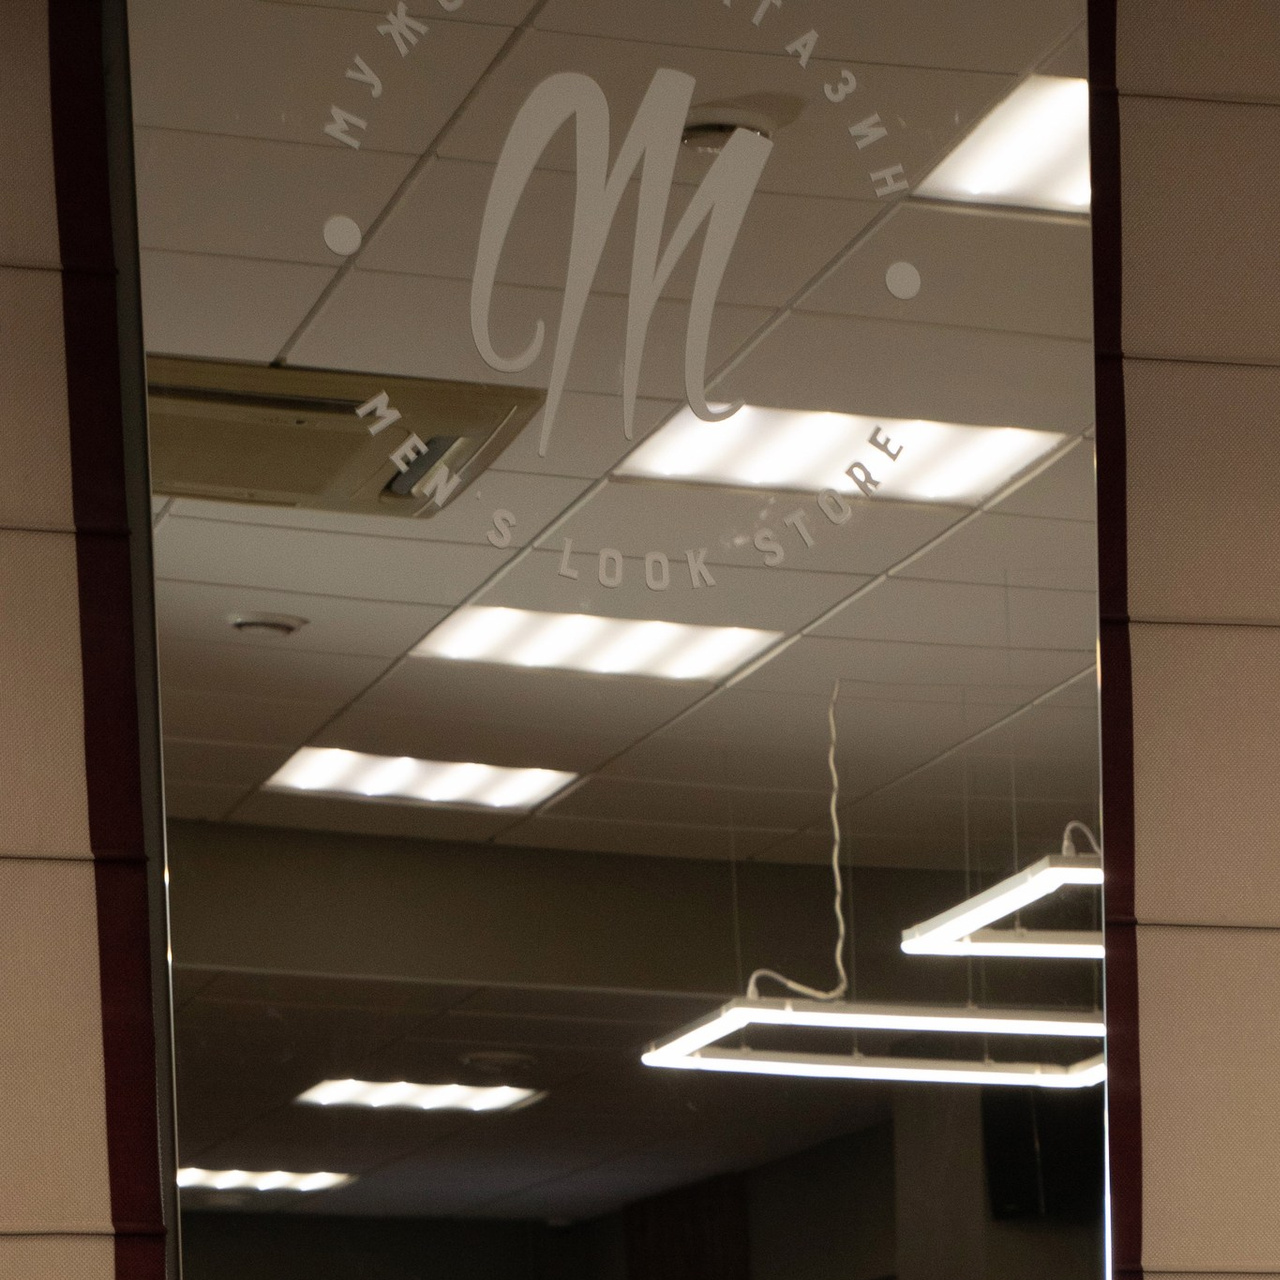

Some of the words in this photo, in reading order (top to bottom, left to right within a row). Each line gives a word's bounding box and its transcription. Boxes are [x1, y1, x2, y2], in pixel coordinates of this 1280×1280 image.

[323, 0, 463, 150] МУЖ
[723, 0, 909, 198] ГАЗИН
[558, 537, 717, 592] LOOK
[753, 425, 904, 567] STORE
